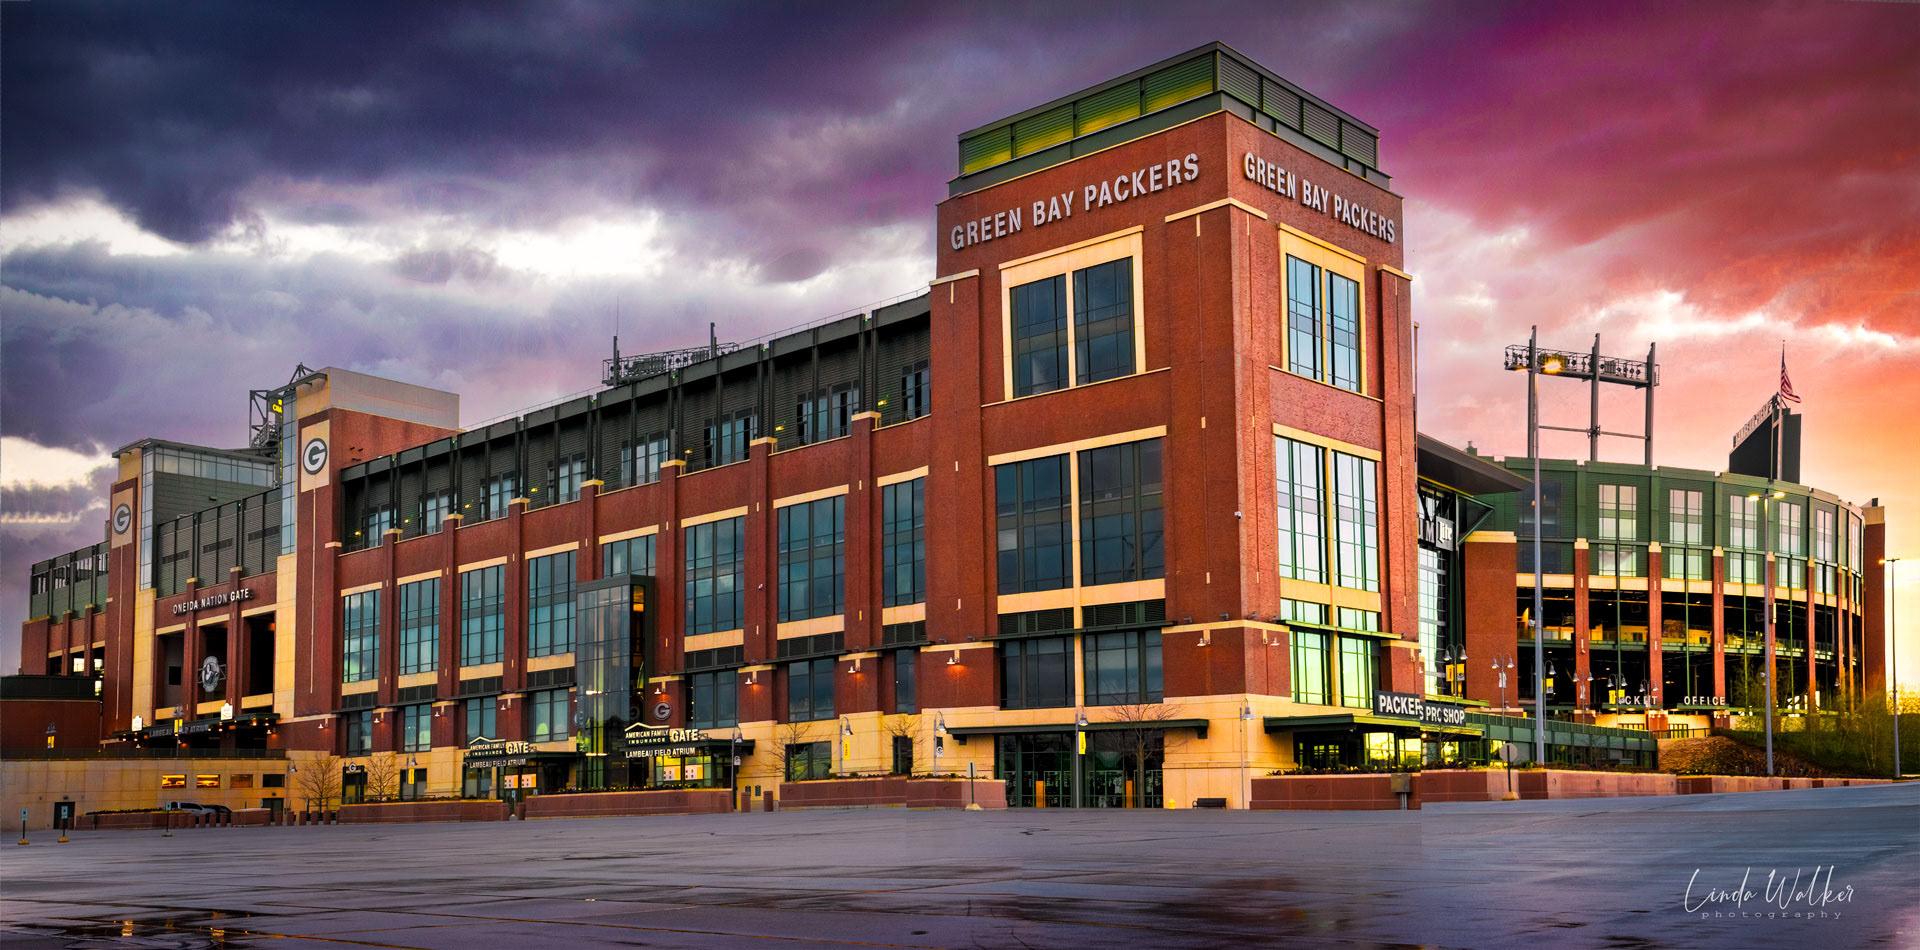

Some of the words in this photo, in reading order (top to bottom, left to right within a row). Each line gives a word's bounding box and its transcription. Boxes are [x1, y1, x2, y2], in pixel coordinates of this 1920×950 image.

[951, 207, 1022, 250] GREEN
[1033, 190, 1074, 226] BAY
[1084, 153, 1200, 211] PACKERS
[1244, 152, 1297, 199] GREEN
[1302, 179, 1329, 213] BAY
[1334, 194, 1396, 244] PACKERS
[303, 438, 327, 474] G
[113, 504, 131, 534] G
[1438, 521, 1453, 543] Lite
[173, 601, 199, 614] ONEIDA
[201, 593, 228, 607] NATION
[230, 588, 249, 601] GATE
[1684, 696, 1726, 705] OFFICE
[654, 702, 671, 720] G
[1443, 707, 1465, 724] SHOP
[149, 729, 173, 738] LAMBEAU
[190, 724, 209, 733] ATRIUM
[625, 731, 650, 739] AMERICAN
[651, 729, 669, 737] FAMILY
[671, 728, 699, 743] GATE
[507, 742, 529, 754] GATE
[625, 750, 653, 758] LAMBEAU
[654, 749, 671, 757] FIELD
[672, 747, 696, 755] ATRIUM
[349, 763, 357, 772] G
[469, 761, 492, 769] LAMBEAU
[507, 758, 526, 766] ATRIUM
